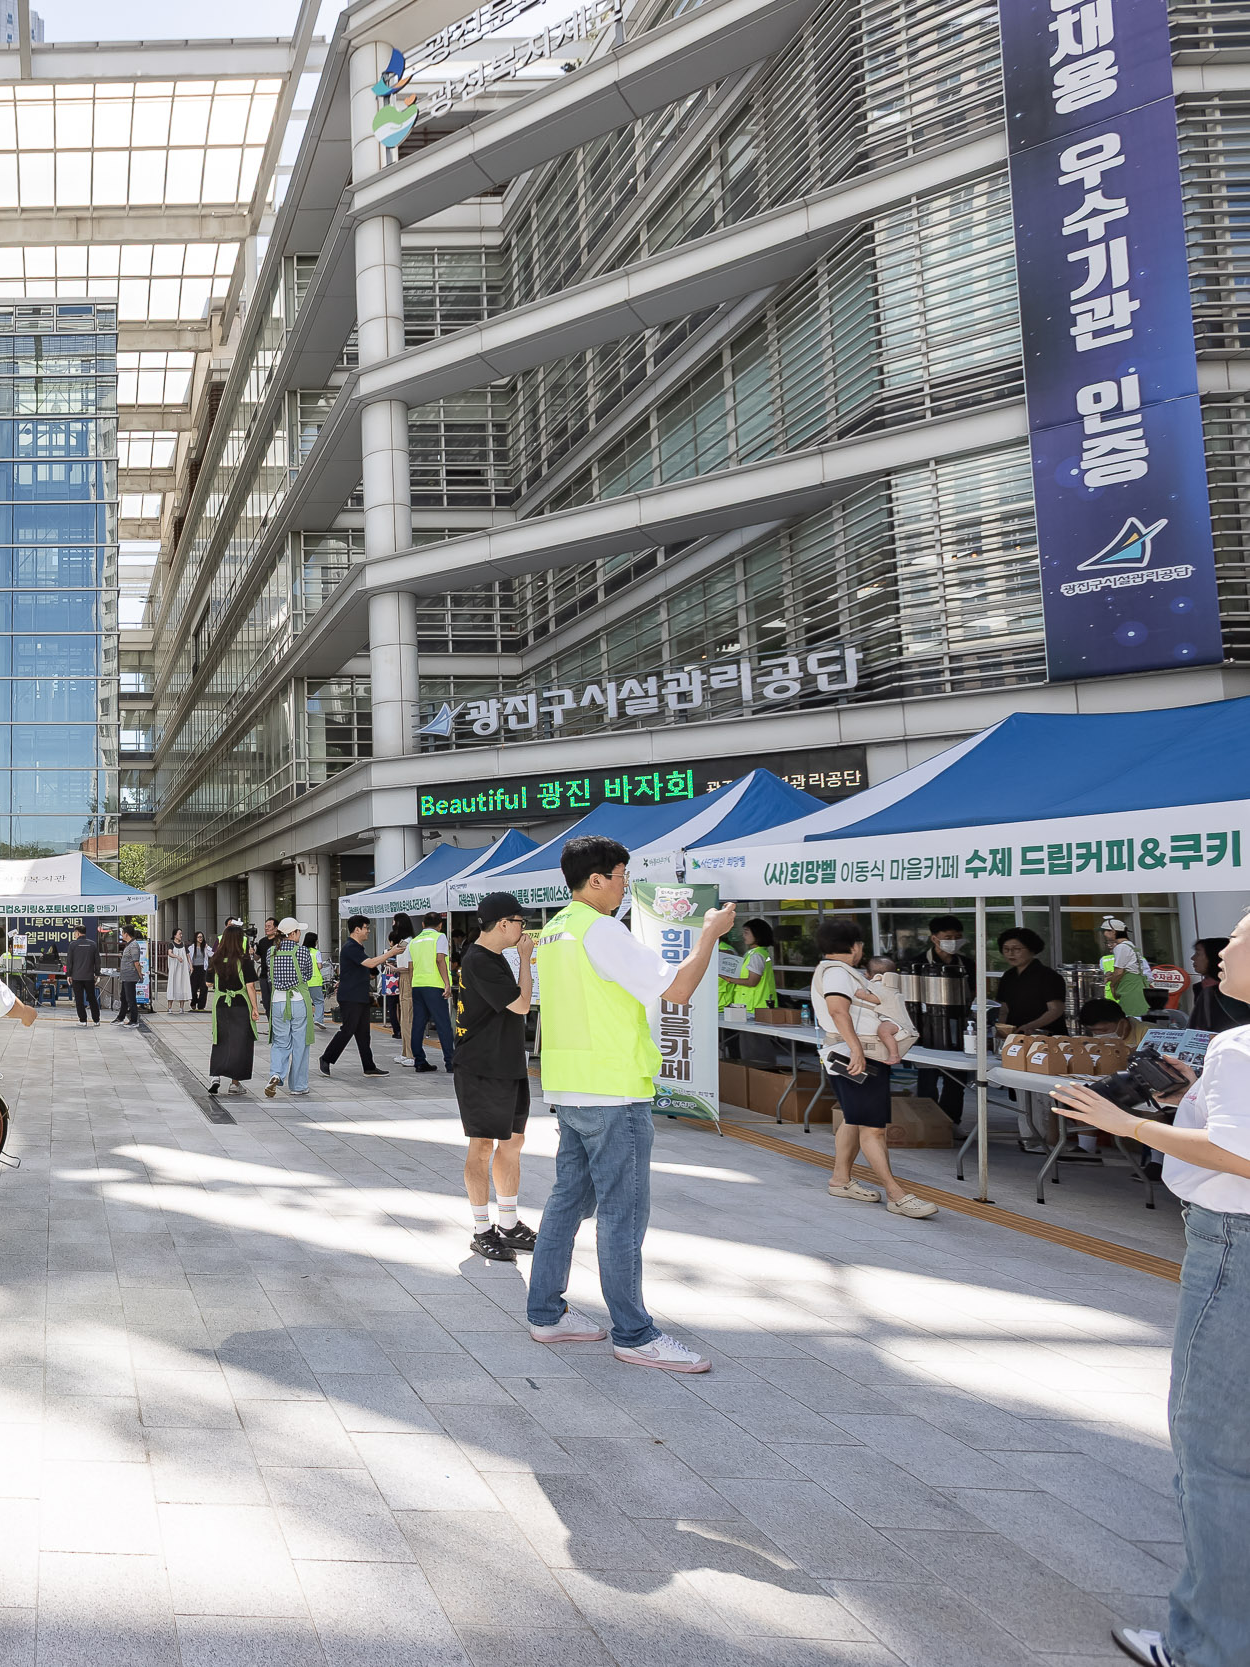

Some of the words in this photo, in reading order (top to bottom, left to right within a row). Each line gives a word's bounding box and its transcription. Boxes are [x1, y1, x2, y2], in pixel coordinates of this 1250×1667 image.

[1056, 131, 1141, 353] 우수기관
[1076, 366, 1150, 488] 인증
[1061, 565, 1192, 596] 광진구시설관리공단
[465, 647, 864, 736] 광진구시설관리공단
[420, 786, 527, 816] Beautiful
[537, 778, 591, 810] 광진
[604, 769, 694, 804] 바자회
[764, 858, 837, 886] (사)희망벨
[840, 859, 885, 883] 이동식
[889, 854, 960, 881] 마을카페
[964, 846, 1013, 879] 수제
[1019, 829, 1242, 876] 드립커피&쿠키
[24, 917, 84, 929] 나루아트센터
[96, 904, 118, 913] 만들기
